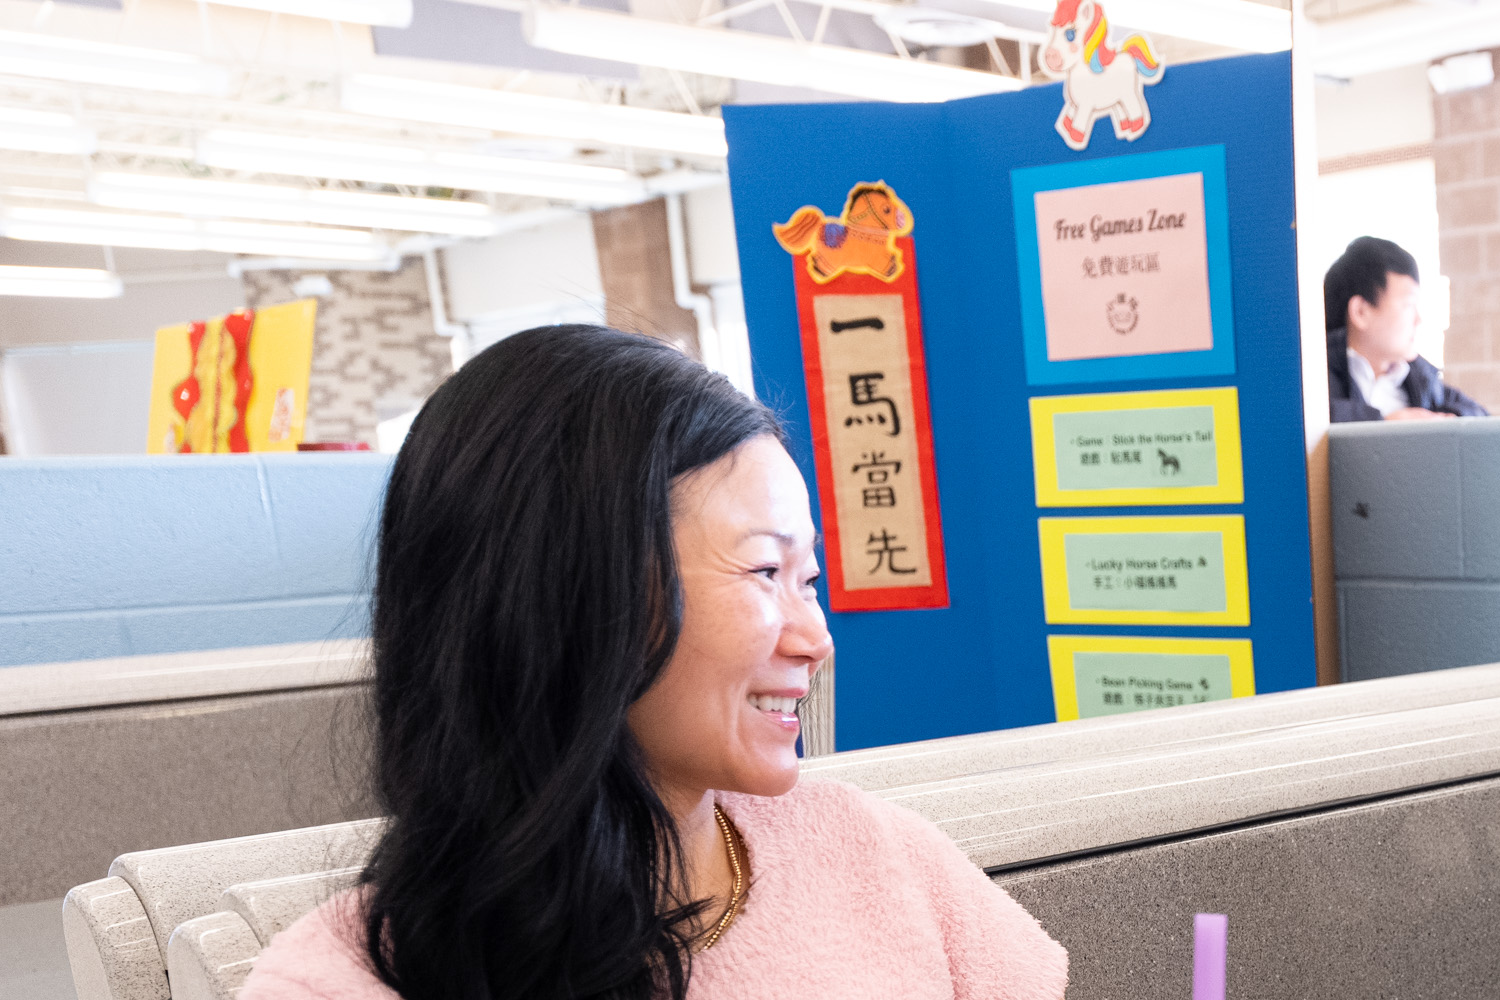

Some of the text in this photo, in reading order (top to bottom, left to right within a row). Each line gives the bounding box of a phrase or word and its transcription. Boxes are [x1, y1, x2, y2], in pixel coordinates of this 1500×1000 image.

[1054, 208, 1186, 242] Free Games Zone
[1082, 252, 1161, 278] 免費遊玩區
[830, 317, 917, 575] 一馬當先
[1091, 557, 1193, 572] Lucky Horse Crafts
[1127, 675, 1164, 691] Picking
